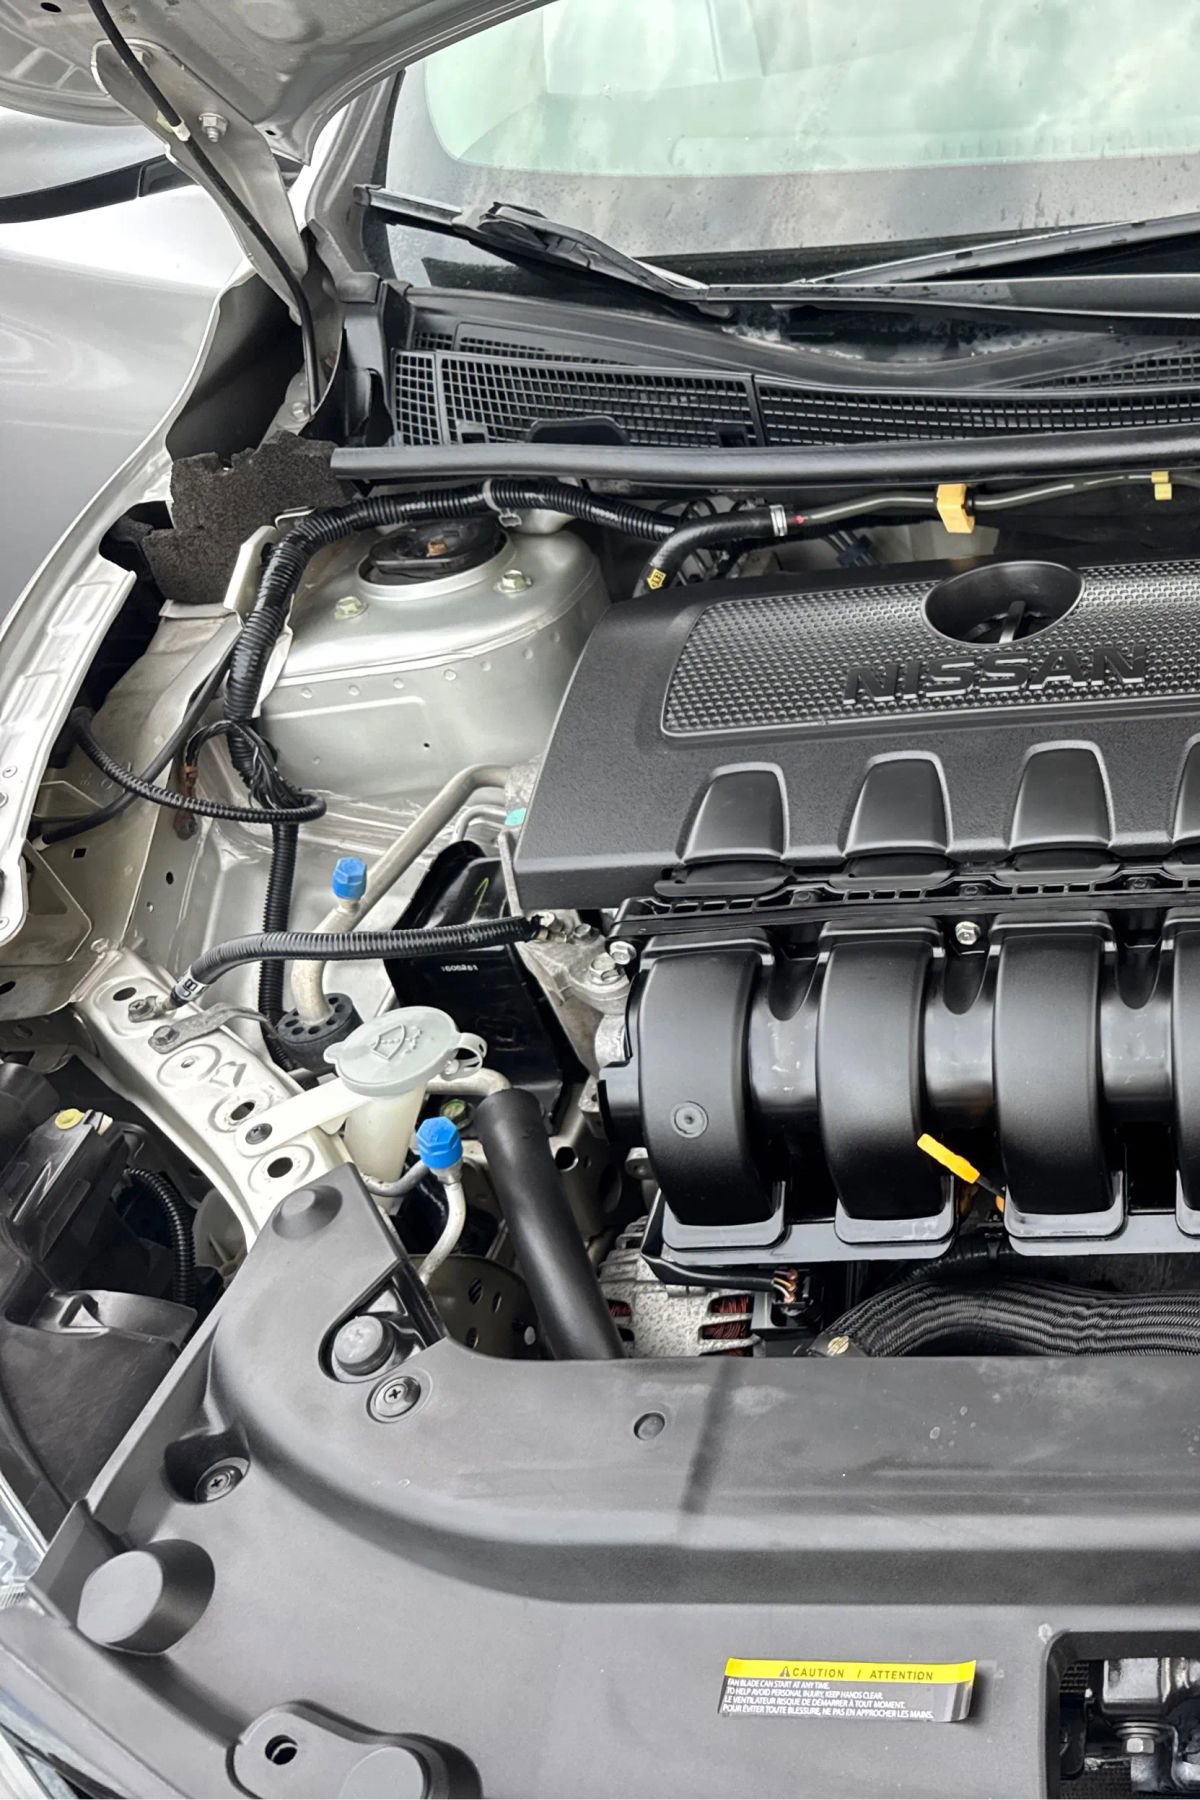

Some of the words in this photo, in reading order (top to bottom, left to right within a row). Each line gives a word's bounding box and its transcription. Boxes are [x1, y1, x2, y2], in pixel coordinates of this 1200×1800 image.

[843, 647, 1147, 704] NISSAN
[792, 1667, 845, 1678] CAUTION
[869, 1670, 933, 1681] ATTENTION
[727, 1678, 739, 1687] FAN
[740, 1679, 760, 1688] BLADE
[760, 1680, 774, 1688] CAN
[774, 1680, 792, 1689] START
[792, 1681, 801, 1689] AT
[801, 1681, 814, 1689] ANY
[727, 1686, 735, 1695] TO
[735, 1687, 751, 1696] HELP
[751, 1688, 770, 1696] AVOID
[771, 1688, 802, 1698] PERSONAL
[825, 1690, 840, 1699] KEEP
[840, 1691, 862, 1699] HANDS
[724, 1695, 733, 1704] LE
[733, 1696, 776, 1705] VENTILATEUR
[777, 1697, 801, 1706] RISQUE
[801, 1698, 811, 1706] DE
[811, 1697, 848, 1708] DÉMARRER
[855, 1699, 873, 1708] TOUT
[723, 1703, 742, 1713] POUR
[742, 1703, 765, 1713] ÉVITER
[765, 1705, 787, 1714] TOUTE
[822, 1707, 832, 1716] NE
[832, 1707, 845, 1717] PAS
[845, 1708, 856, 1717] EN
[856, 1708, 897, 1718] APPROCHER
[897, 1709, 910, 1718] LES
